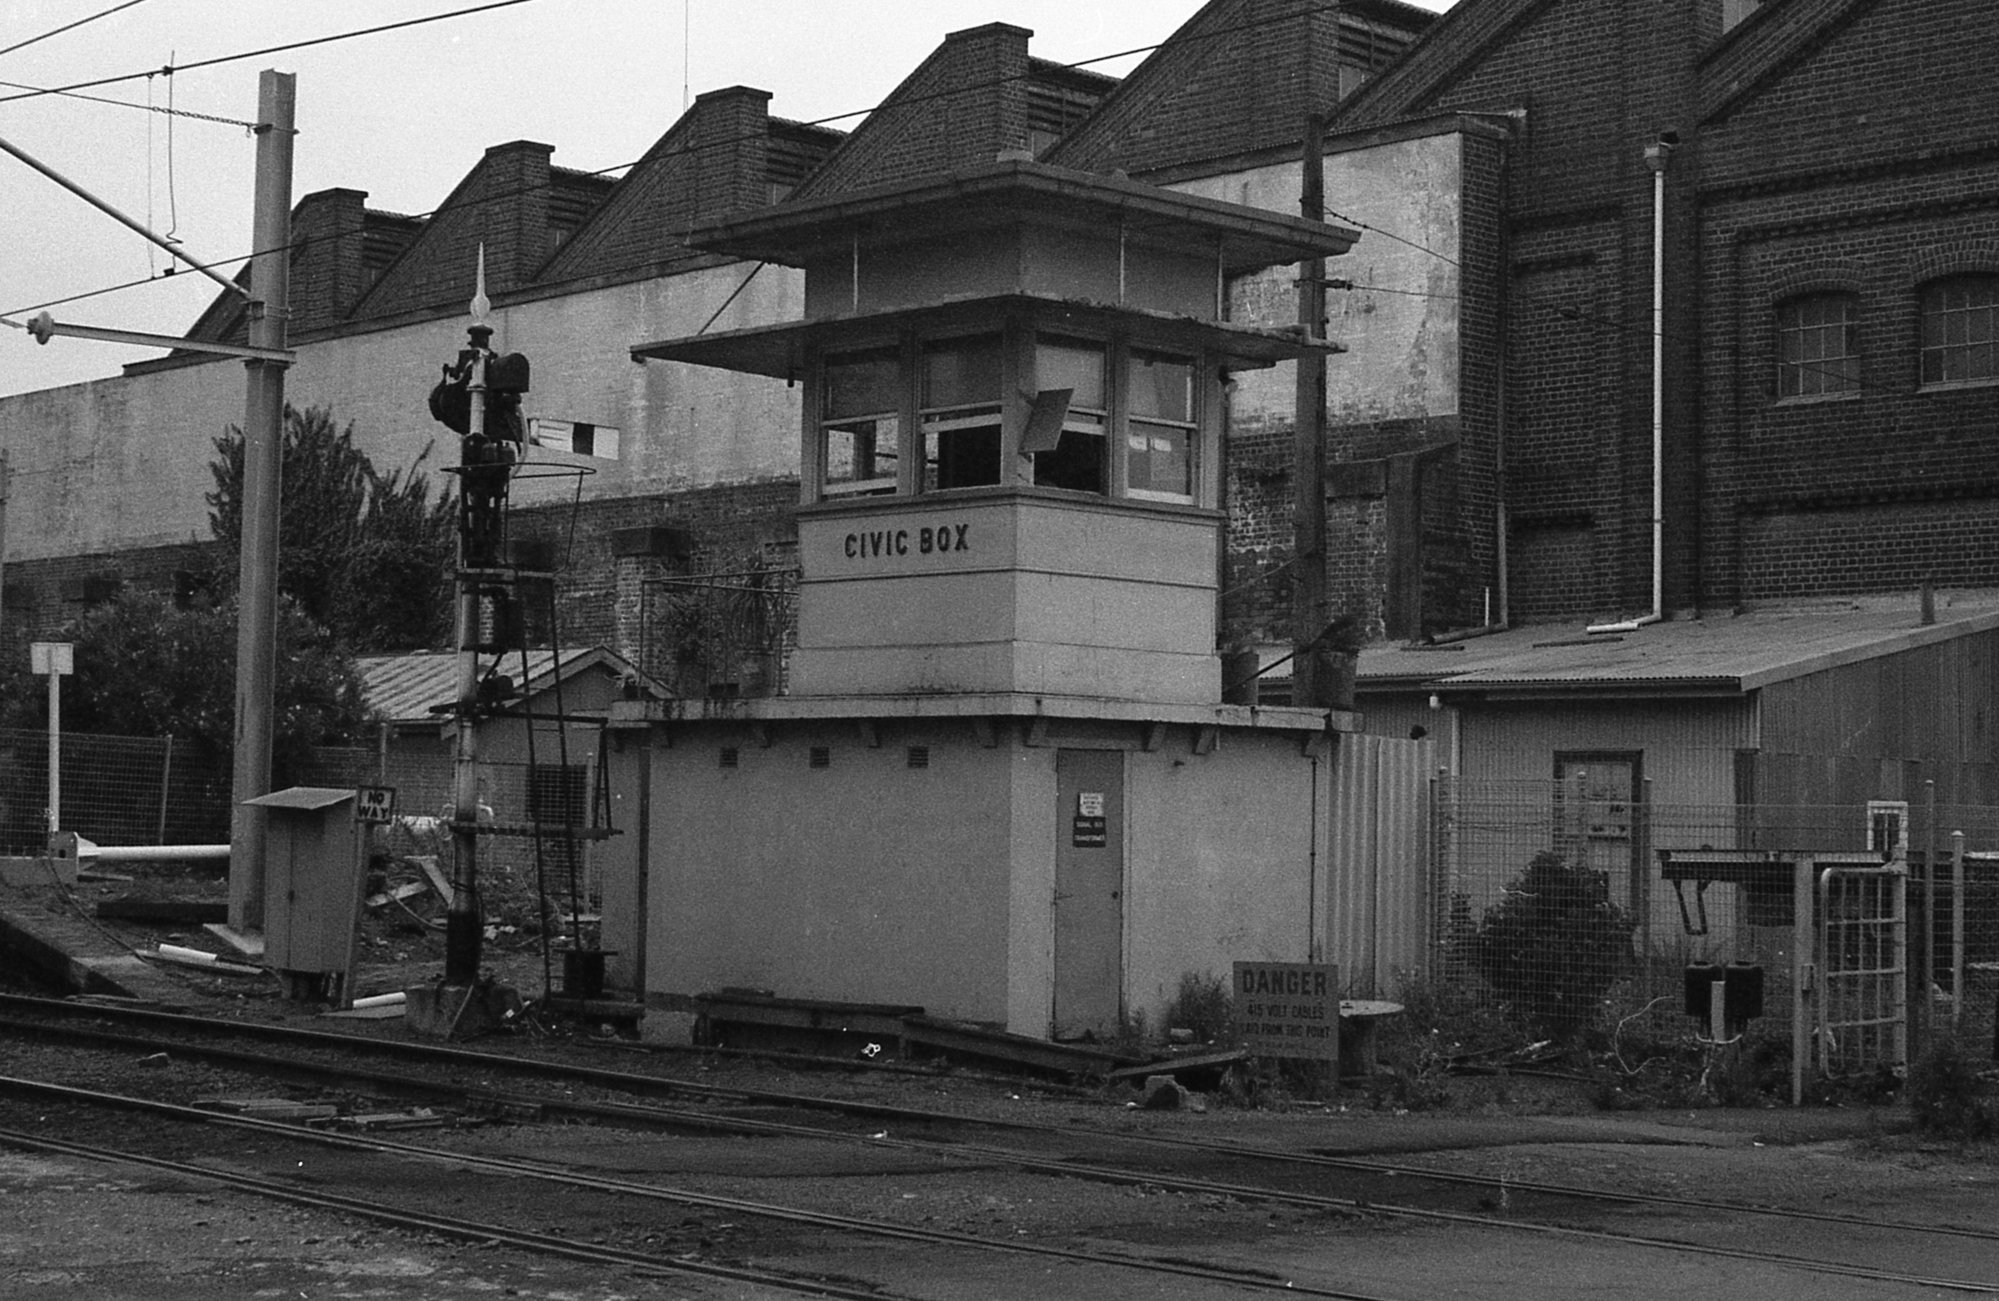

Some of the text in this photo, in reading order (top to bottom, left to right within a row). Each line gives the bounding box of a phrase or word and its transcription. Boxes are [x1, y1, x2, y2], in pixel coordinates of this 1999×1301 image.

[844, 523, 969, 558] CIVIC BOX
[368, 790, 385, 804] NO
[359, 805, 389, 819] WAY
[1242, 969, 1327, 996] DANGER
[1267, 1004, 1287, 1018] VOLT
[1291, 1005, 1325, 1020] CABLES
[1261, 1022, 1283, 1036] FROM
[1306, 1025, 1331, 1039] POINT
